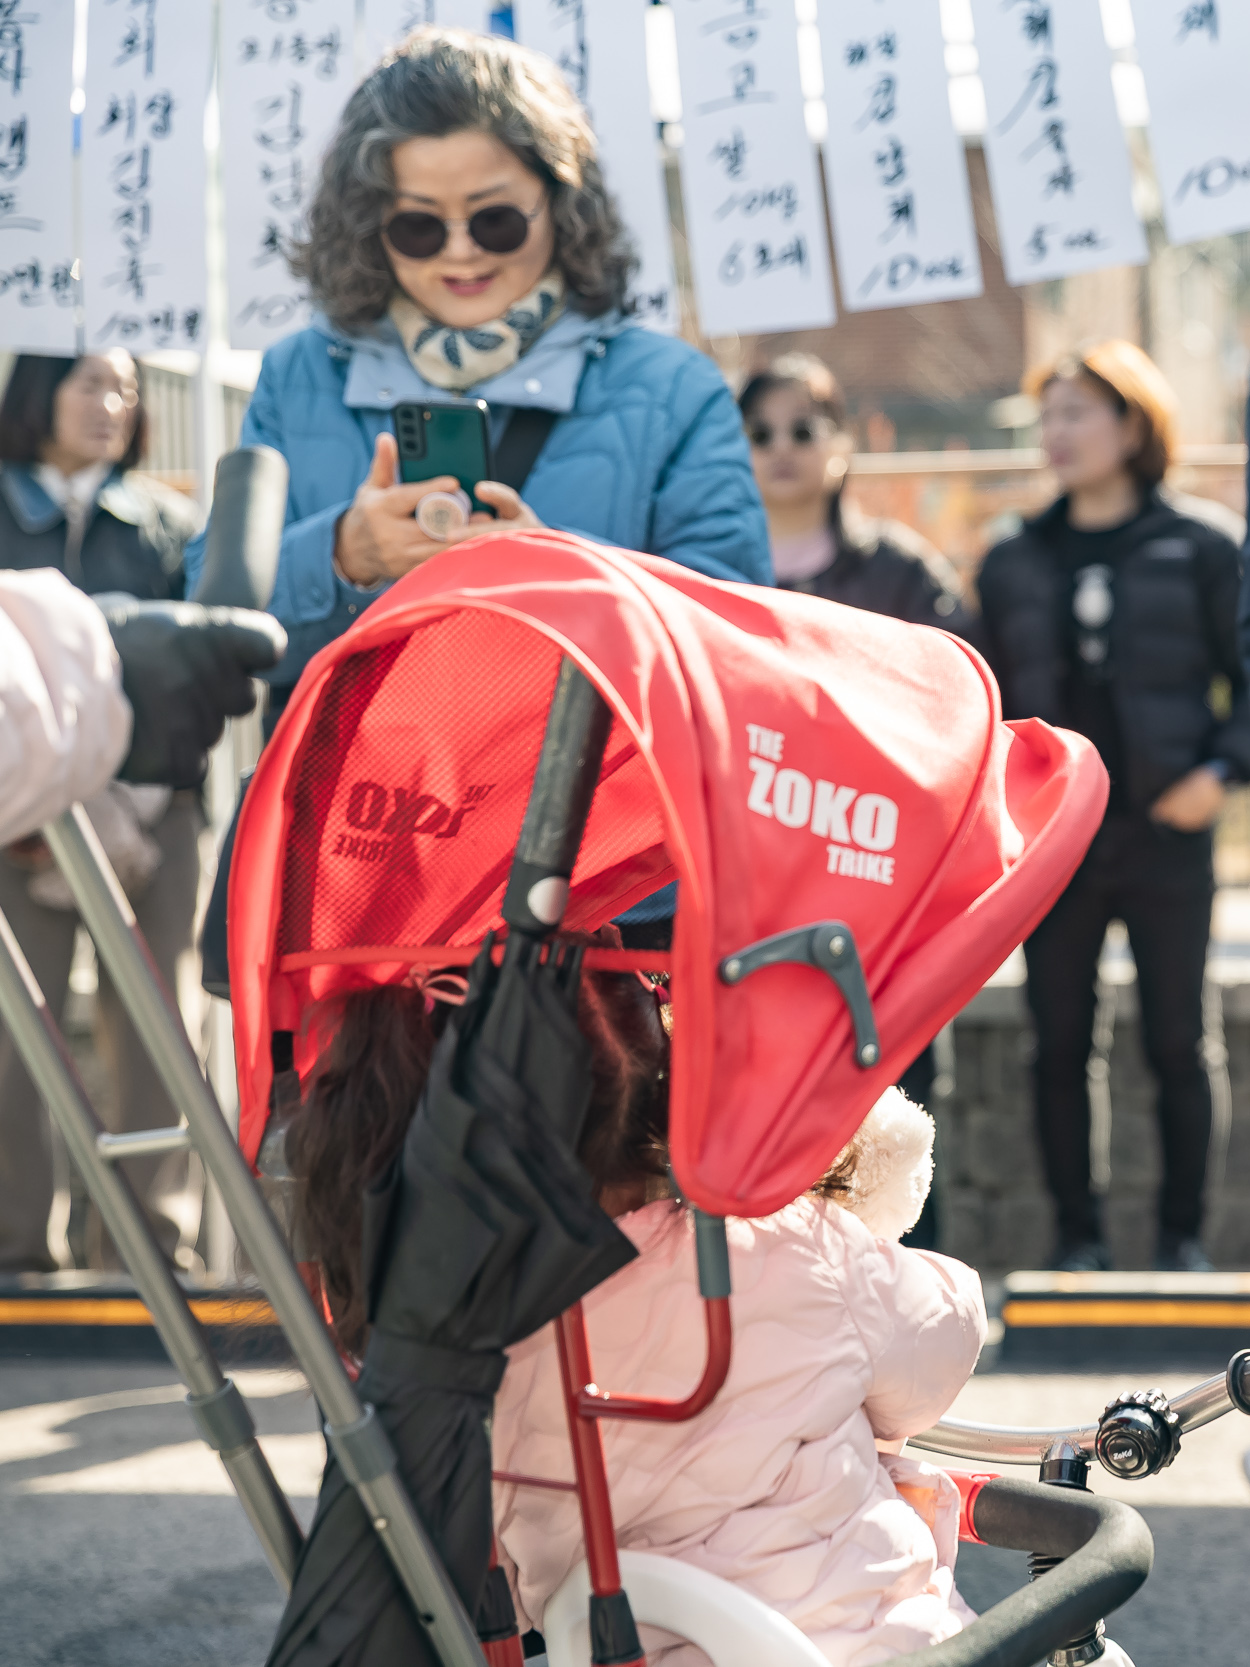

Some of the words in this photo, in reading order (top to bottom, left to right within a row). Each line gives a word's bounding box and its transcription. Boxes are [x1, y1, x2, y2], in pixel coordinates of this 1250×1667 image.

[746, 722, 785, 762] THE
[747, 755, 899, 852] ZOKO
[826, 843, 895, 886] TRIKE
